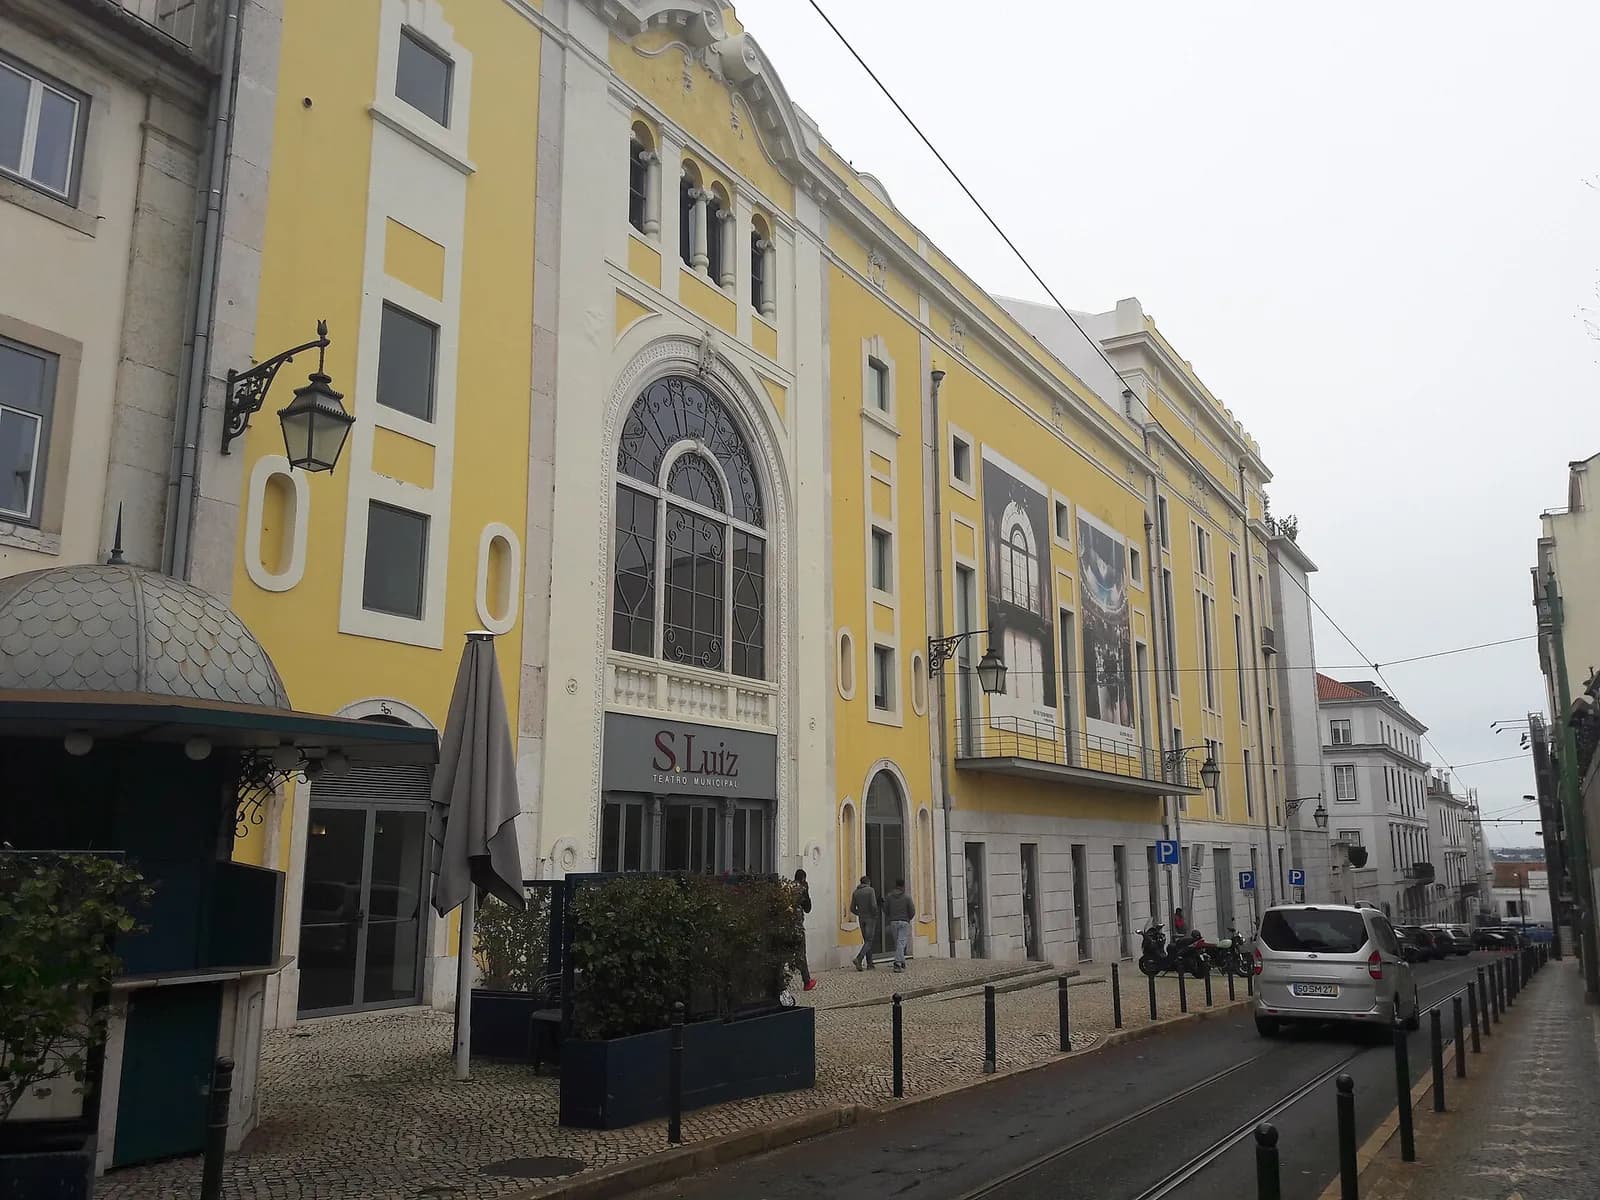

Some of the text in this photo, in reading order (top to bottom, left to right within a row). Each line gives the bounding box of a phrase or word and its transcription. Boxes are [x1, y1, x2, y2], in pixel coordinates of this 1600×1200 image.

[653, 774, 738, 789] TEATRO MUNICIPAL
[1160, 842, 1174, 862] P
[1242, 873, 1251, 888] P
[1292, 870, 1302, 884] P
